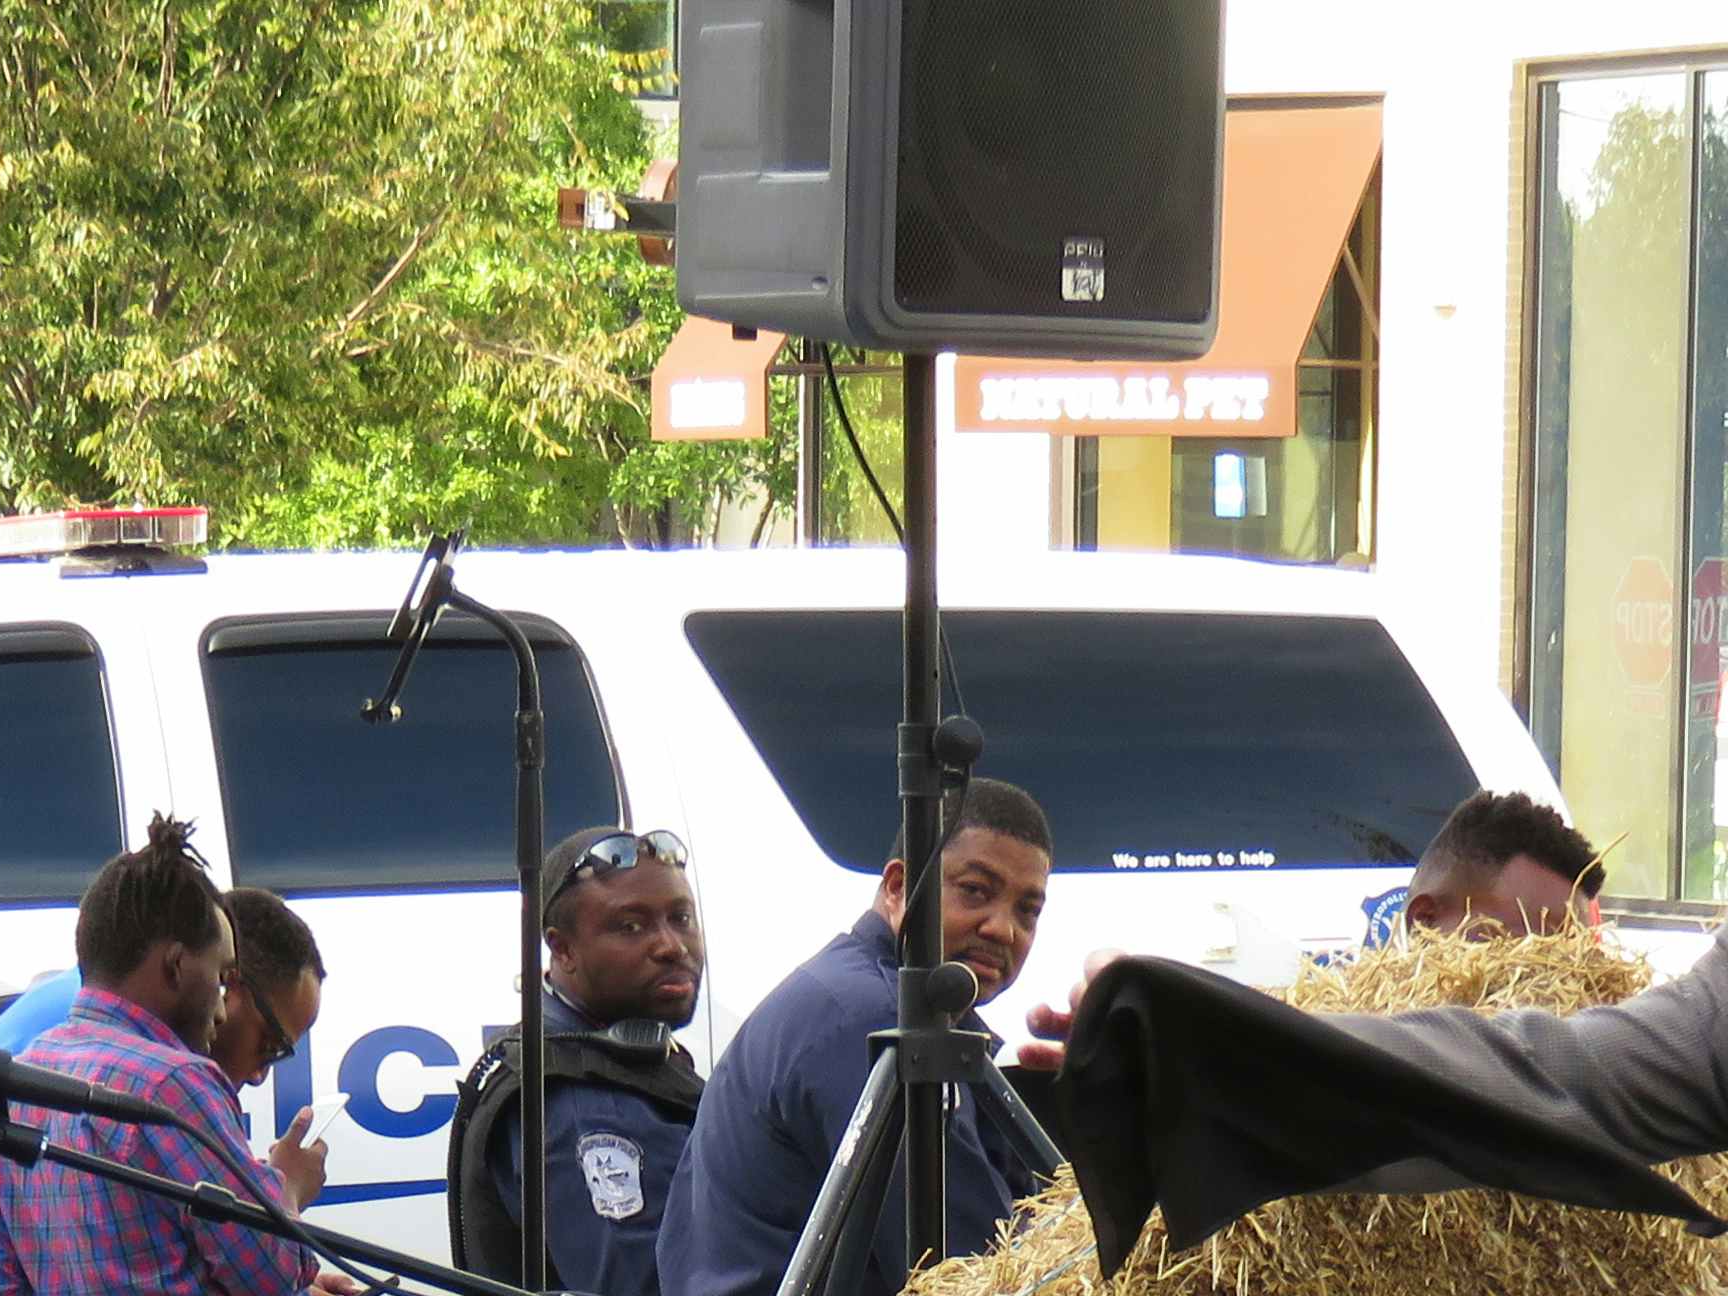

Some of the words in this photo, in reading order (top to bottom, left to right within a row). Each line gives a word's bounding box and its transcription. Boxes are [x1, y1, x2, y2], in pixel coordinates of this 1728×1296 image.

[980, 376, 1180, 420] NATURAL
[1183, 376, 1269, 420] PET
[1113, 853, 1139, 868] We
[1144, 855, 1170, 867] are
[1176, 852, 1212, 867] here
[1217, 852, 1234, 866] to
[1239, 850, 1275, 868] help
